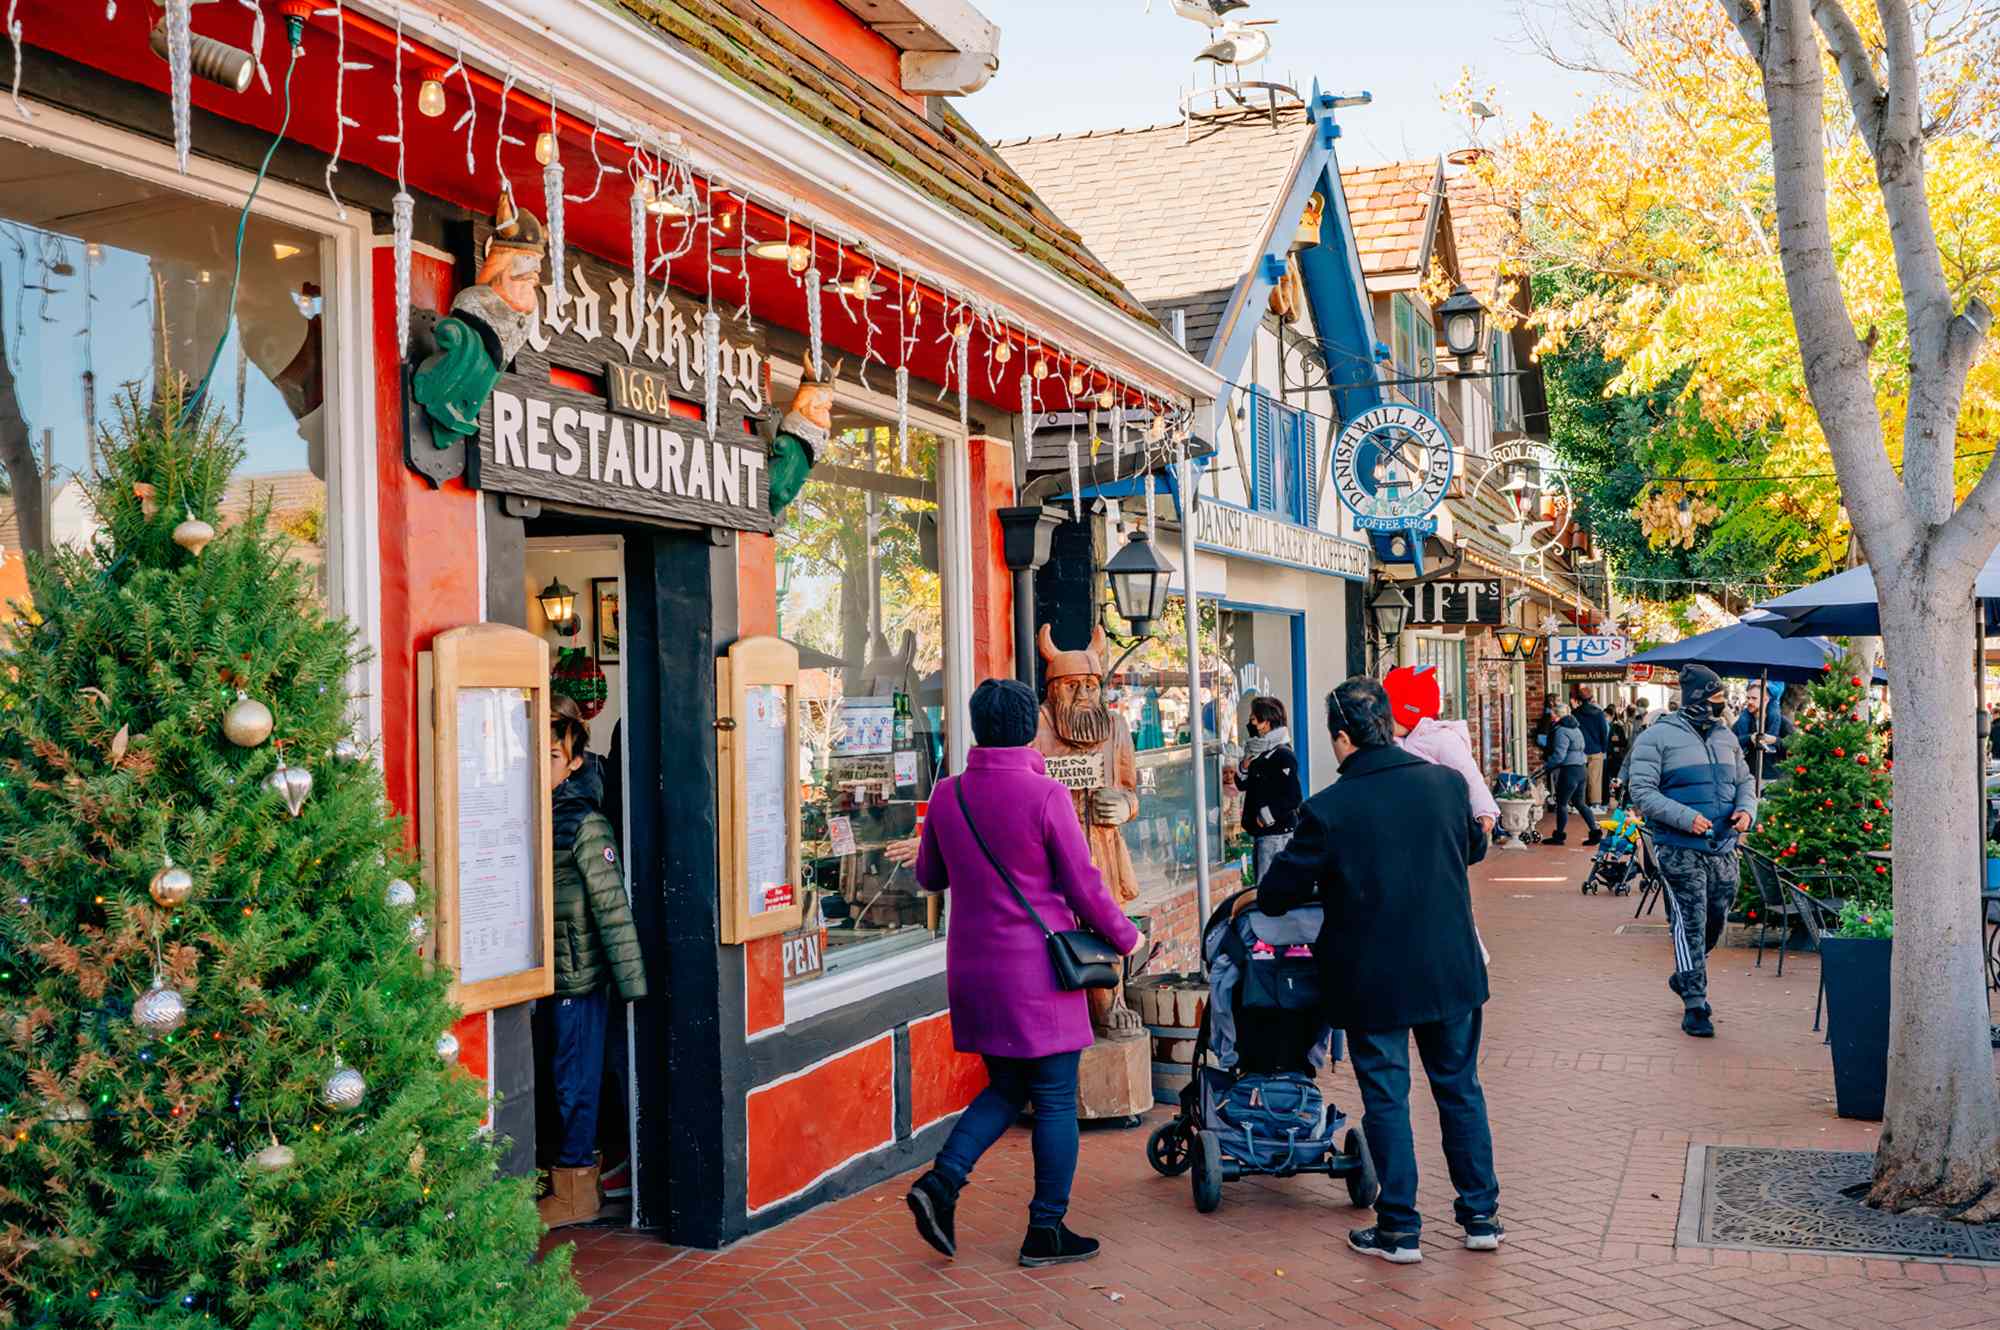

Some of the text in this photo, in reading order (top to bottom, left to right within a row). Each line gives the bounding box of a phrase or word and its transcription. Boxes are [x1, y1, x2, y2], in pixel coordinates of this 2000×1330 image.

[609, 277, 762, 414] Viking
[616, 366, 671, 418] 1684
[492, 390, 765, 509] RESTAURANT
[1335, 407, 1449, 507] DANISH MILL BAKERY
[1196, 501, 1242, 549] DANISH
[1246, 514, 1270, 555] MILL
[1273, 522, 1310, 565] BAKERY
[1349, 544, 1368, 577] SHOP
[1356, 518, 1433, 531] COFFEE SHOP
[1412, 581, 1499, 623] IFTS
[1554, 638, 1622, 662] HATS
[1045, 759, 1068, 769] THE
[1048, 766, 1093, 778] VIKING
[783, 934, 820, 978] PEN
